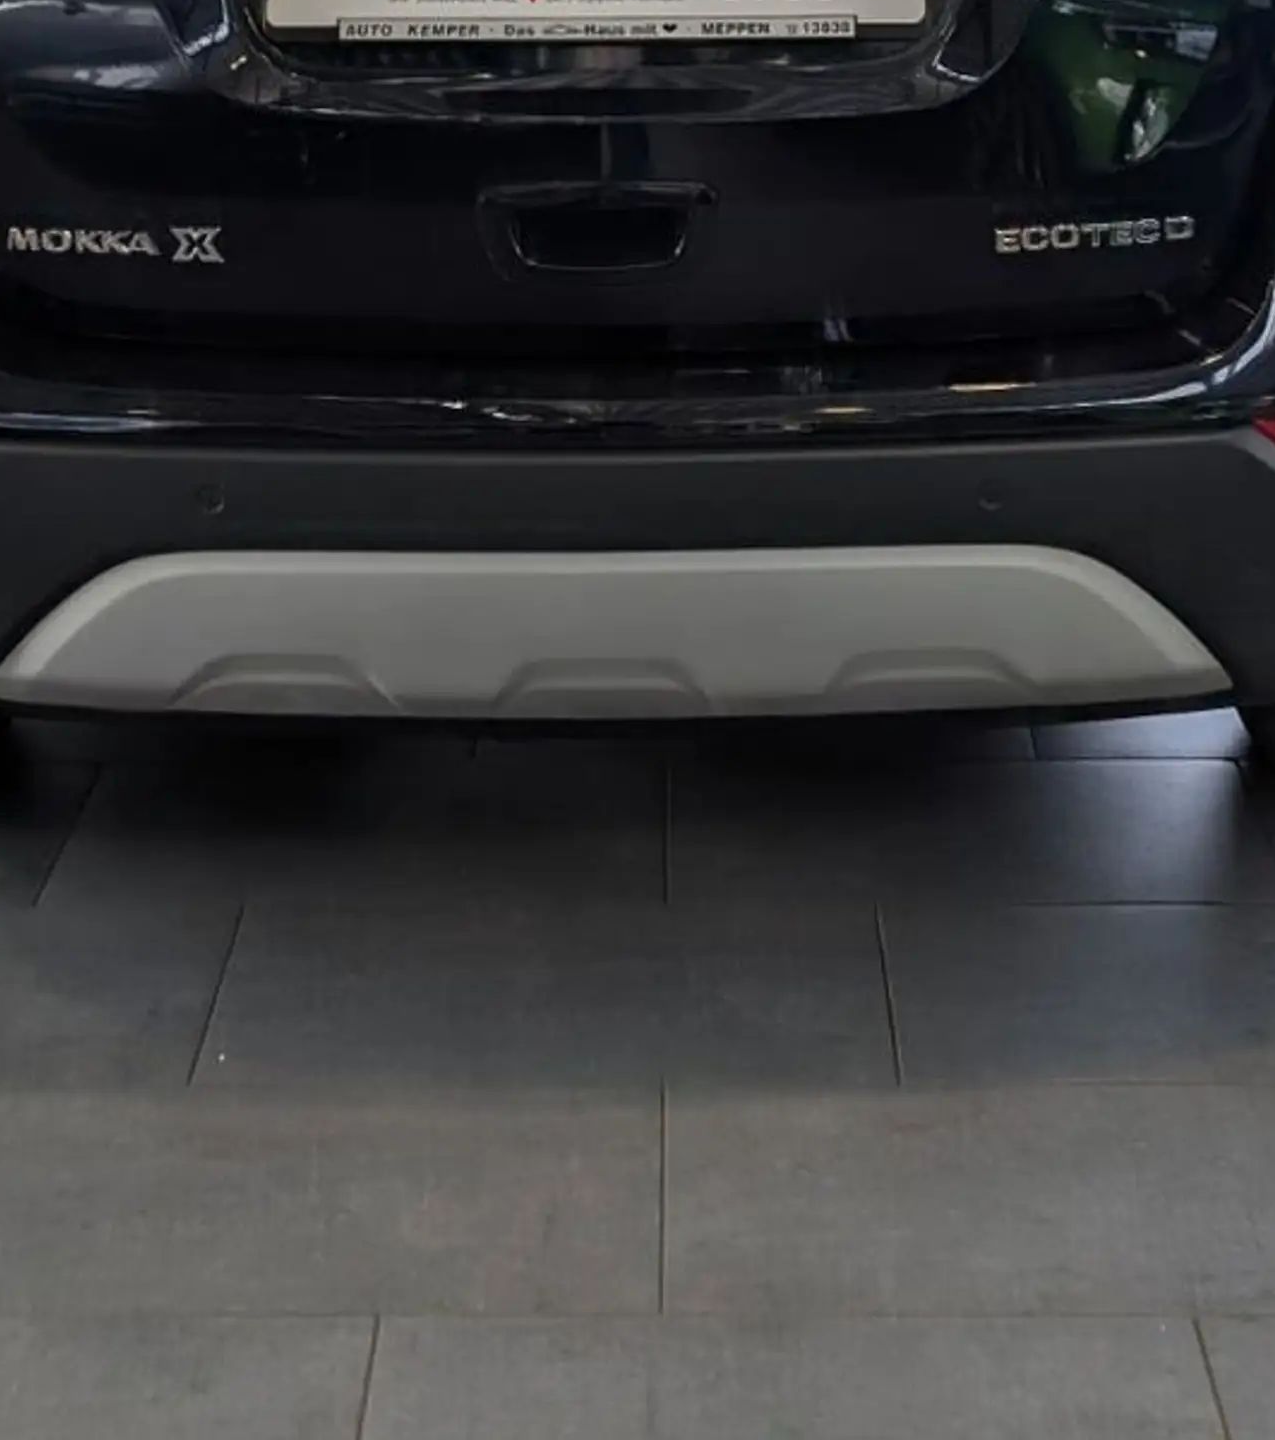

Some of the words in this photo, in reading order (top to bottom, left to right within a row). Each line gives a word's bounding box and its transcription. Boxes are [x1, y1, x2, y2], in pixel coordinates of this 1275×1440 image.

[345, 23, 393, 37] AUTO
[407, 23, 481, 37] KEMPER
[504, 23, 535, 36] Das
[701, 21, 771, 35] MEPPEN
[7, 226, 161, 256] MOKKA
[169, 226, 225, 263] X
